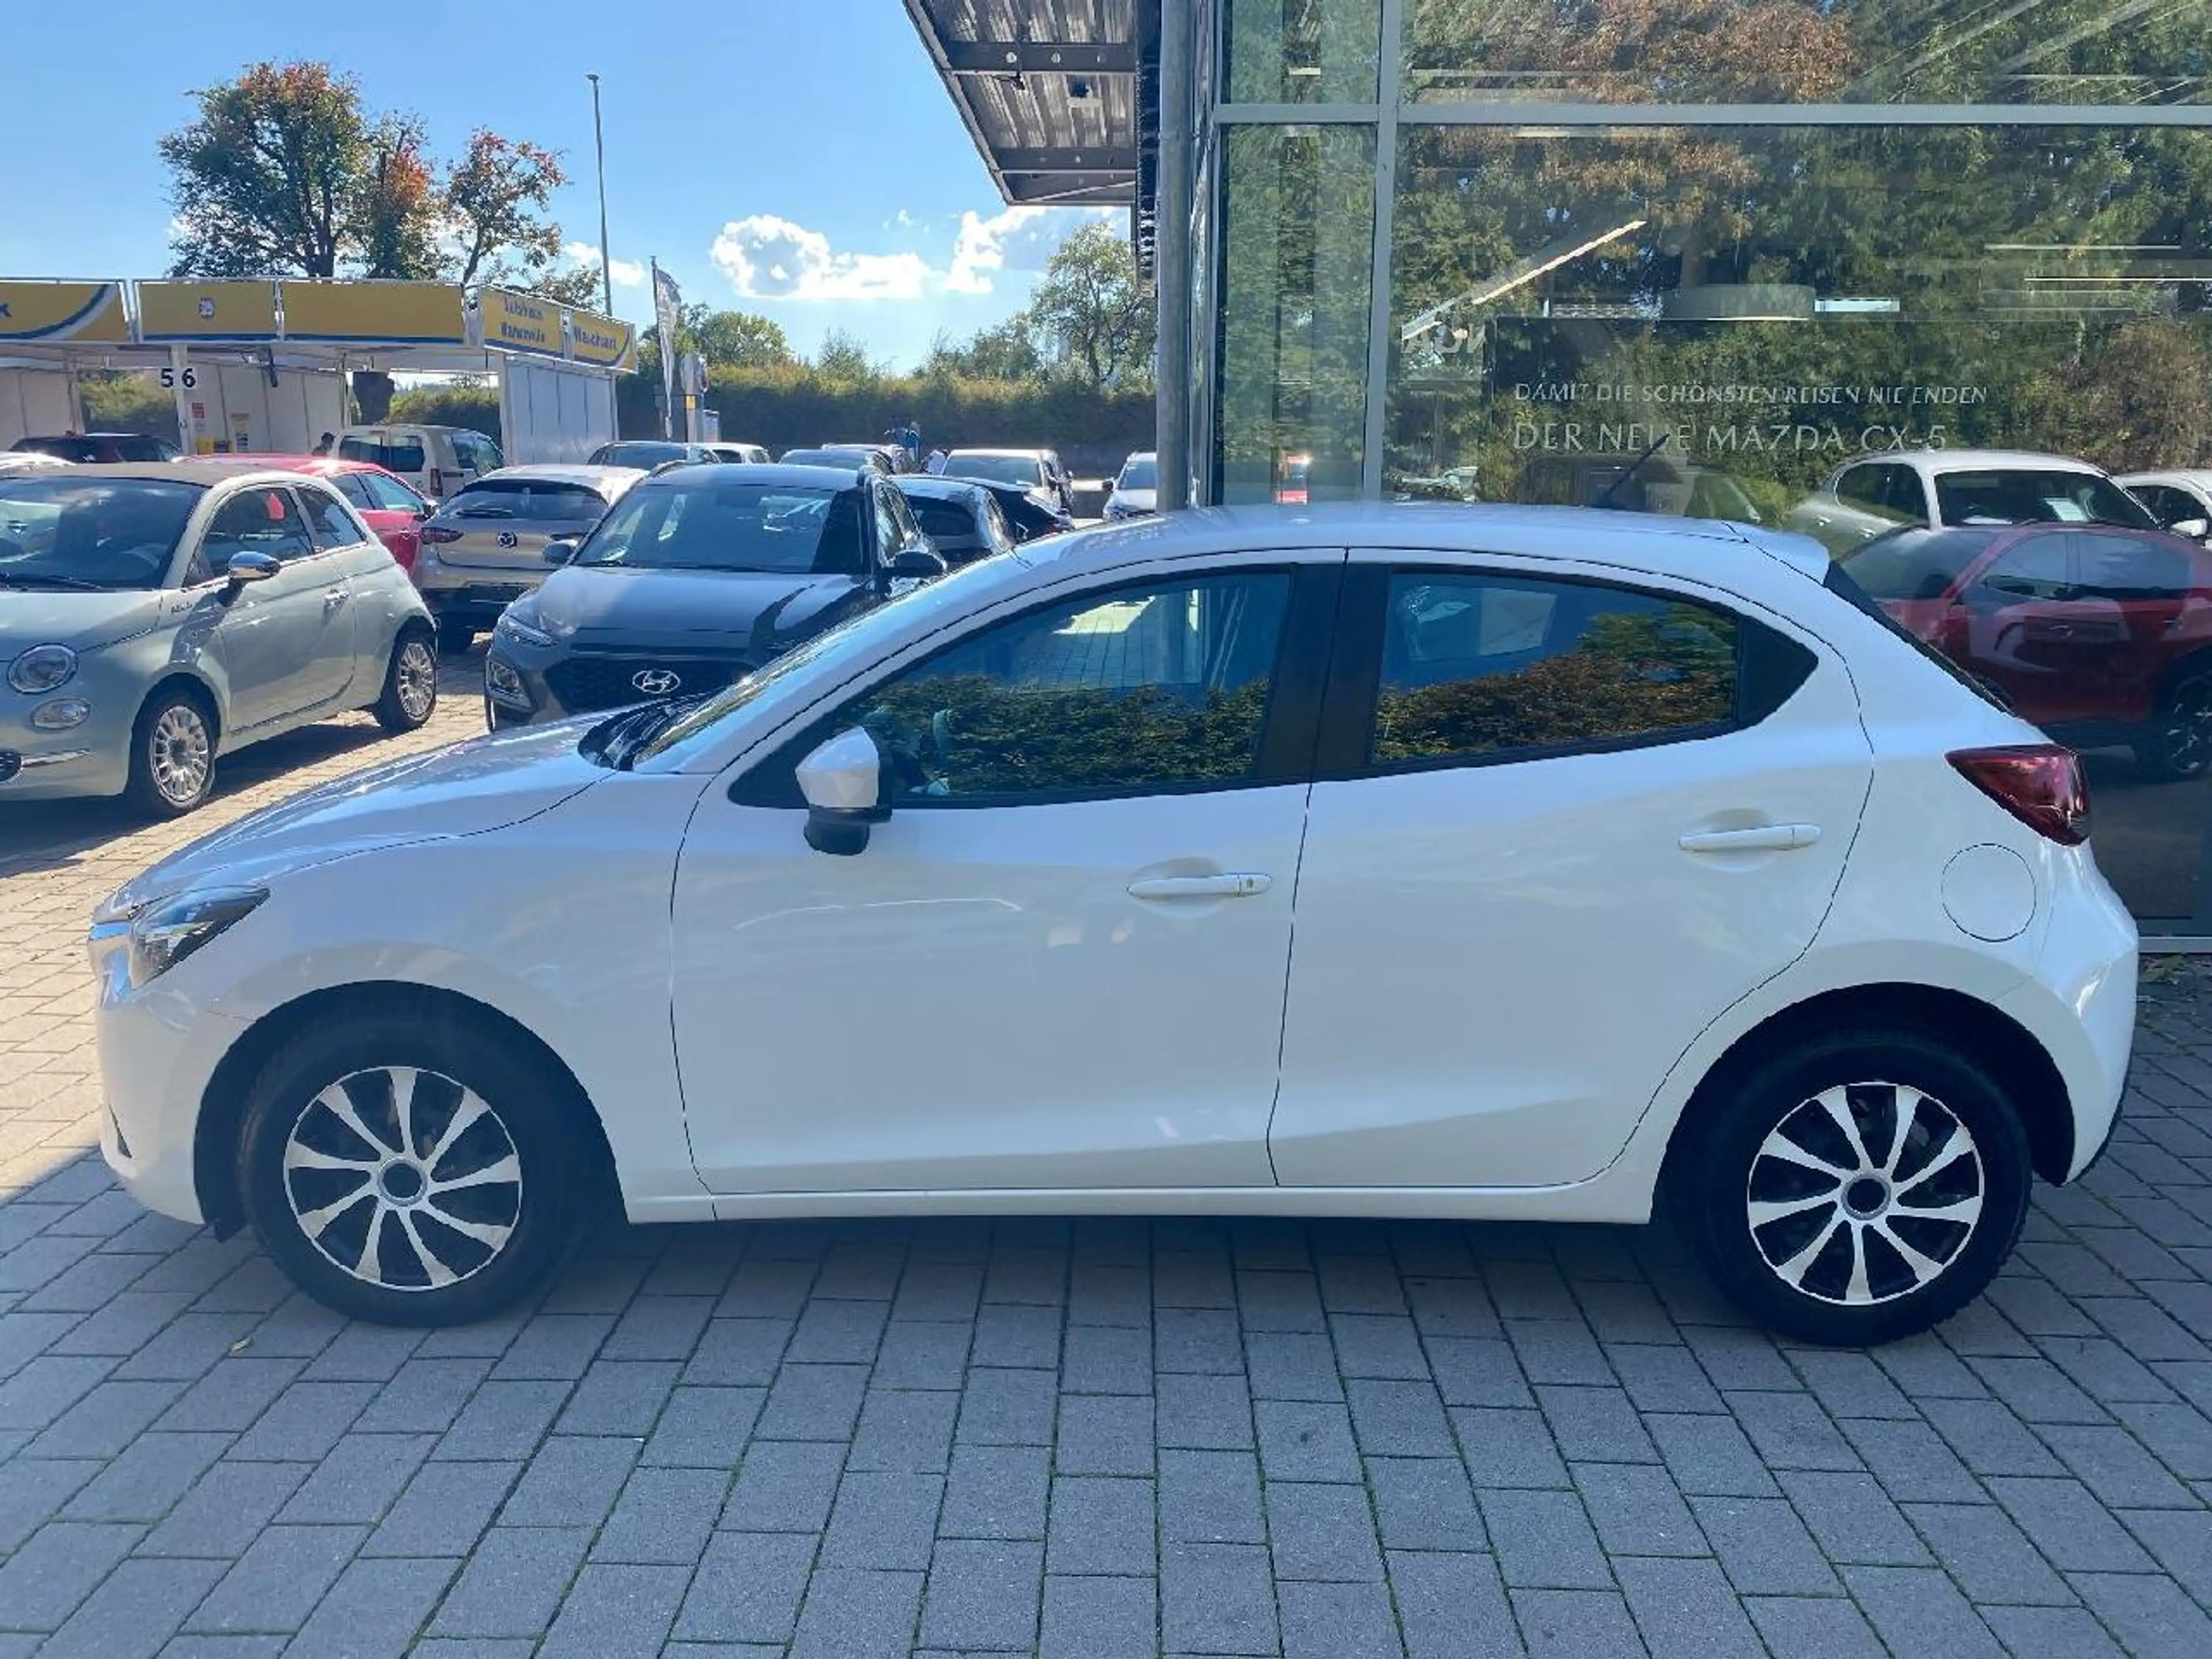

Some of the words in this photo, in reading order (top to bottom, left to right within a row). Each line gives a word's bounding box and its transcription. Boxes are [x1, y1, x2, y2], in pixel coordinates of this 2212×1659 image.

[161, 368, 173, 388] 5
[182, 368, 196, 388] 6
[1514, 383, 1588, 402] DAMIT
[1597, 384, 1633, 402] DIE
[1642, 381, 1776, 403] SCHÖNSTEN
[1784, 387, 1860, 403] REISEN
[1868, 387, 1903, 403] NIE
[1913, 387, 1987, 404] ENDEN
[1514, 423, 1583, 450] DER
[1598, 423, 1691, 450] NEUE
[1707, 425, 1844, 451] MAZDA
[1860, 425, 1945, 451] CX-5
